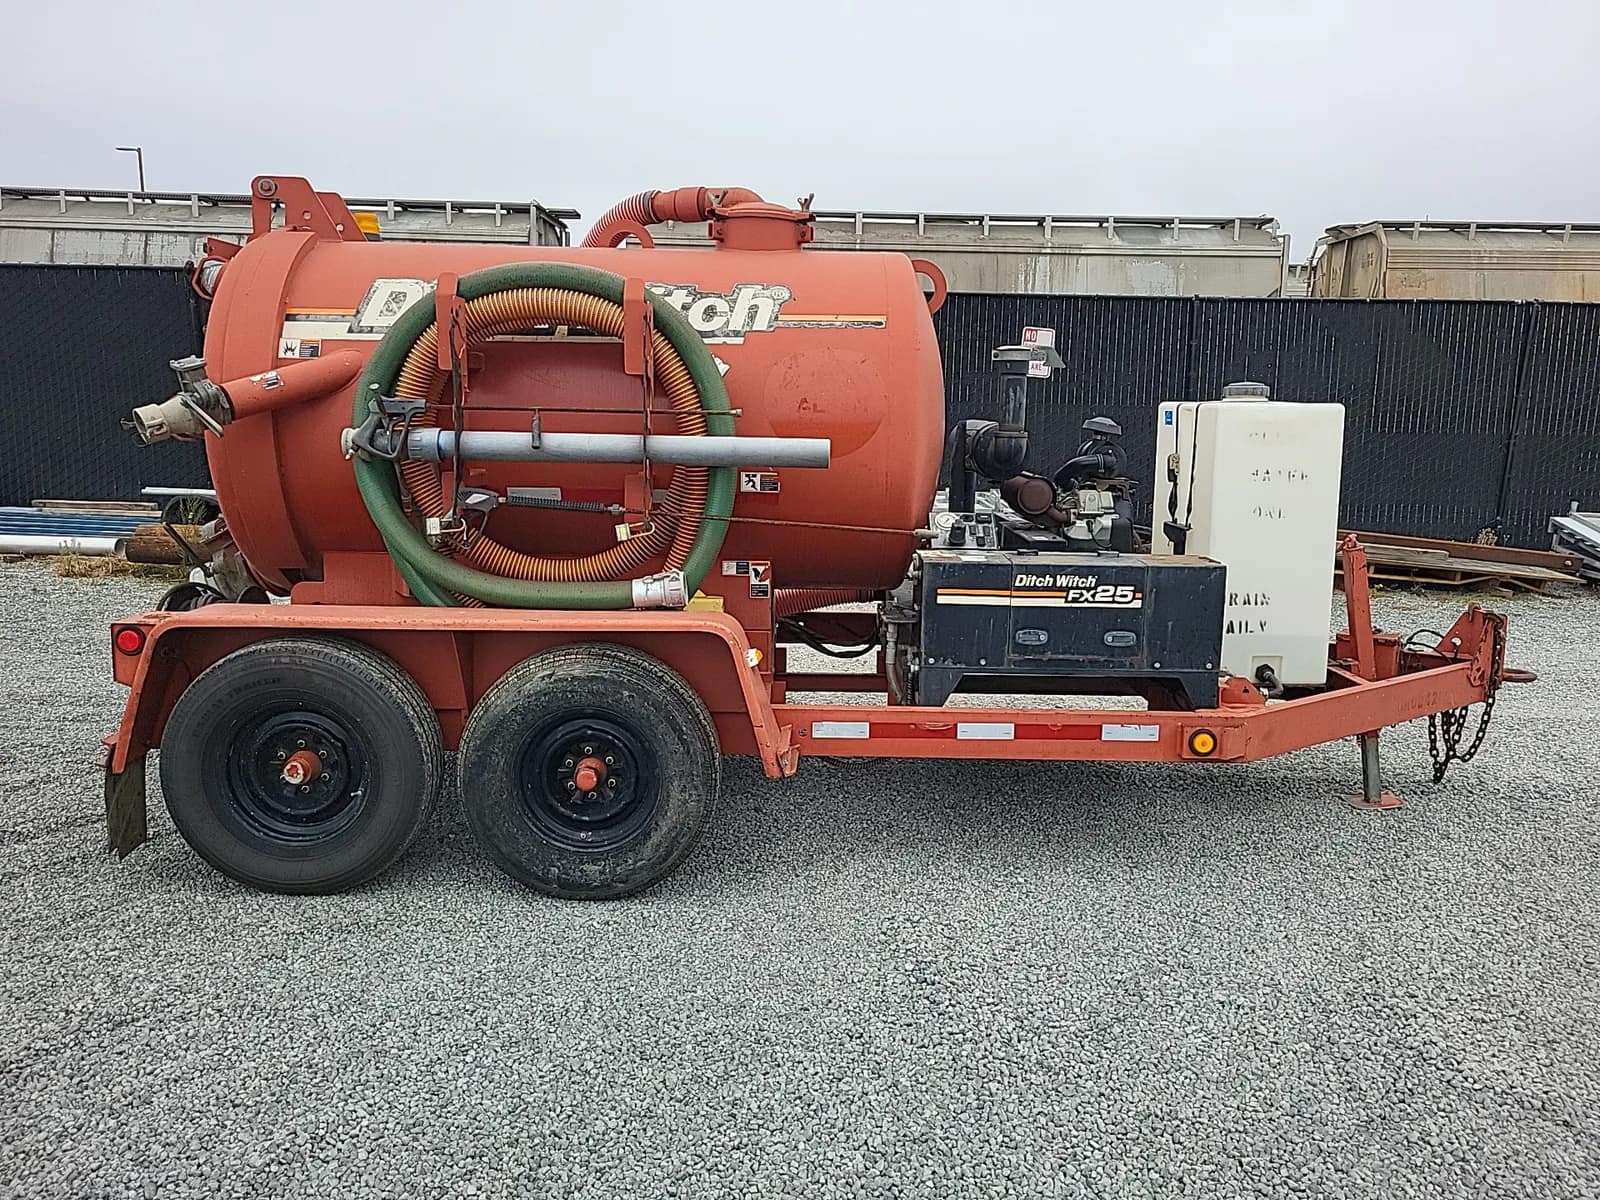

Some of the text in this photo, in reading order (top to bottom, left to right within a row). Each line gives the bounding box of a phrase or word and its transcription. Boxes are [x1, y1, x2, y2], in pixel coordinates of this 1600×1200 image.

[1025, 330, 1037, 342] NO
[1014, 574, 1097, 588] Ditch Witch
[1067, 585, 1135, 603] FX25
[1229, 592, 1271, 606] RAIN
[1226, 620, 1267, 634] AILY
